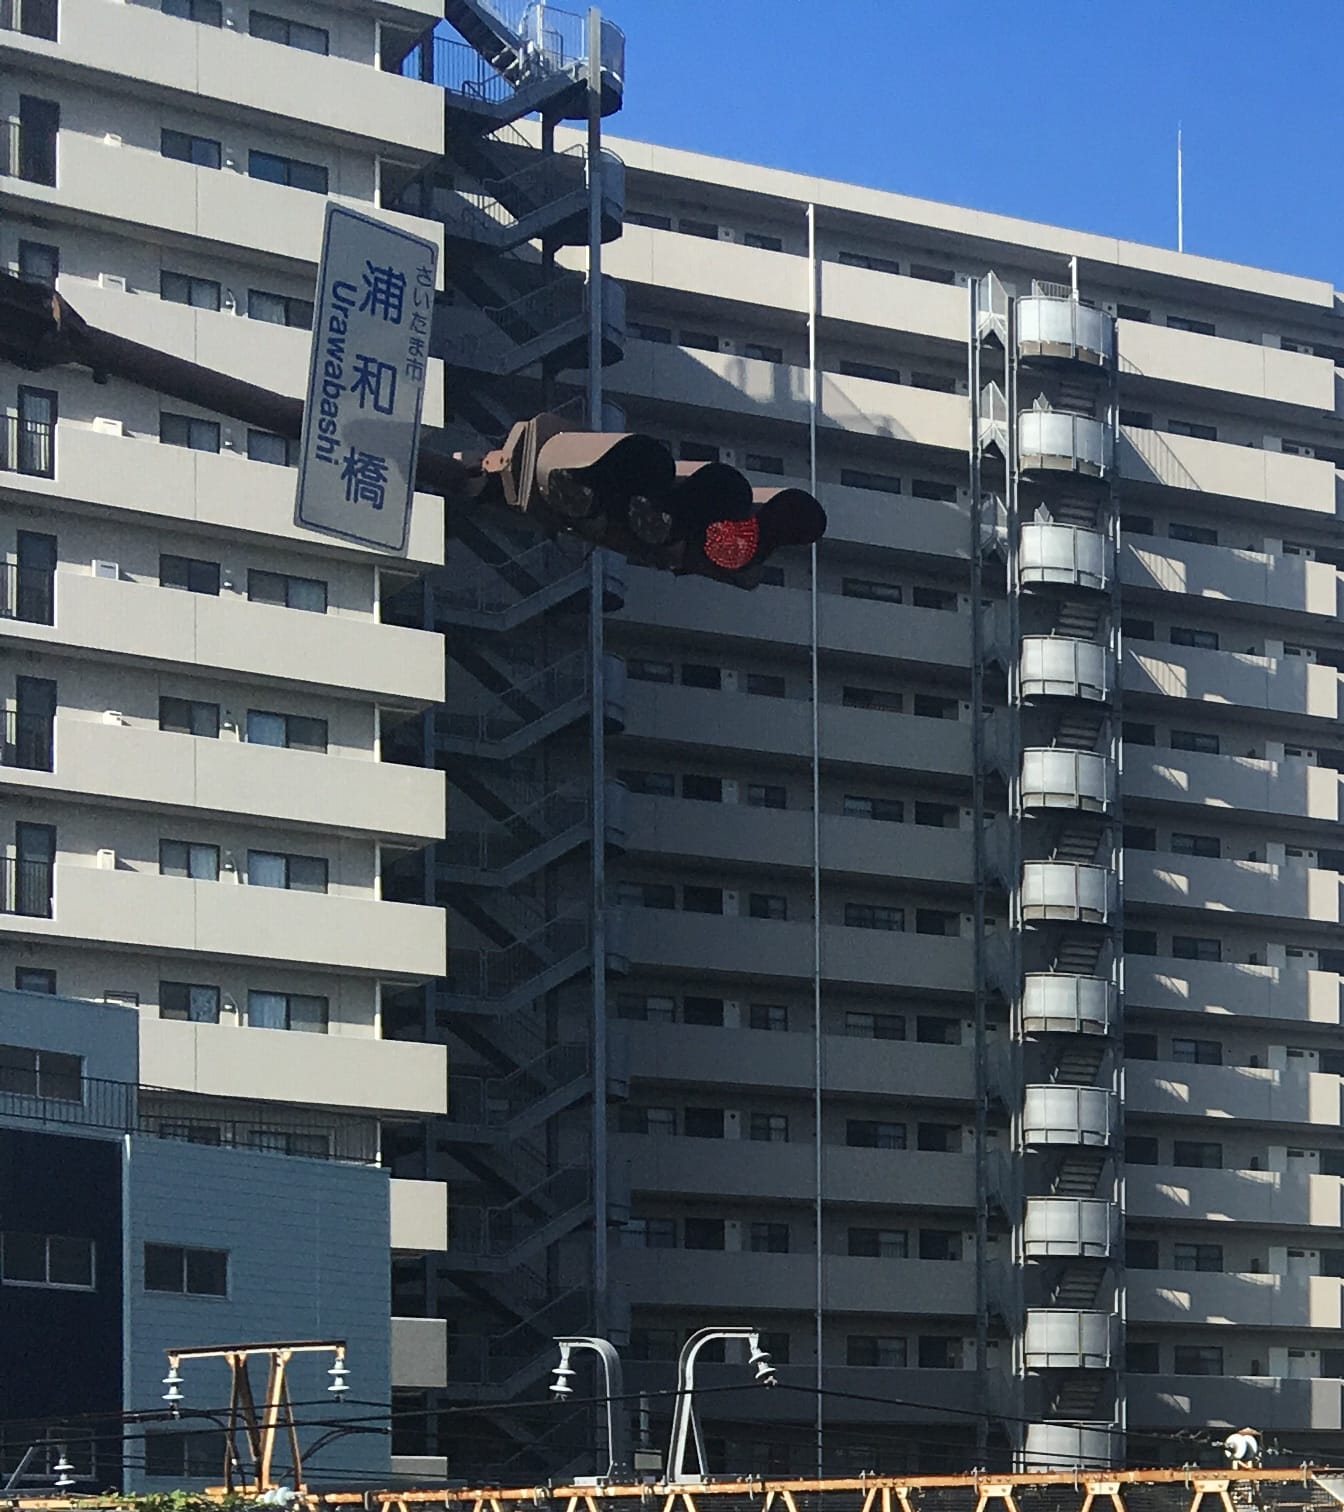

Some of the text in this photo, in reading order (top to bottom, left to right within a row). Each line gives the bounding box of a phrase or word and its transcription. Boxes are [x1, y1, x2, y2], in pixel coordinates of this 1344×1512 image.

[314, 279, 358, 465] Urawabashi
[340, 259, 408, 511] 浦和橋
